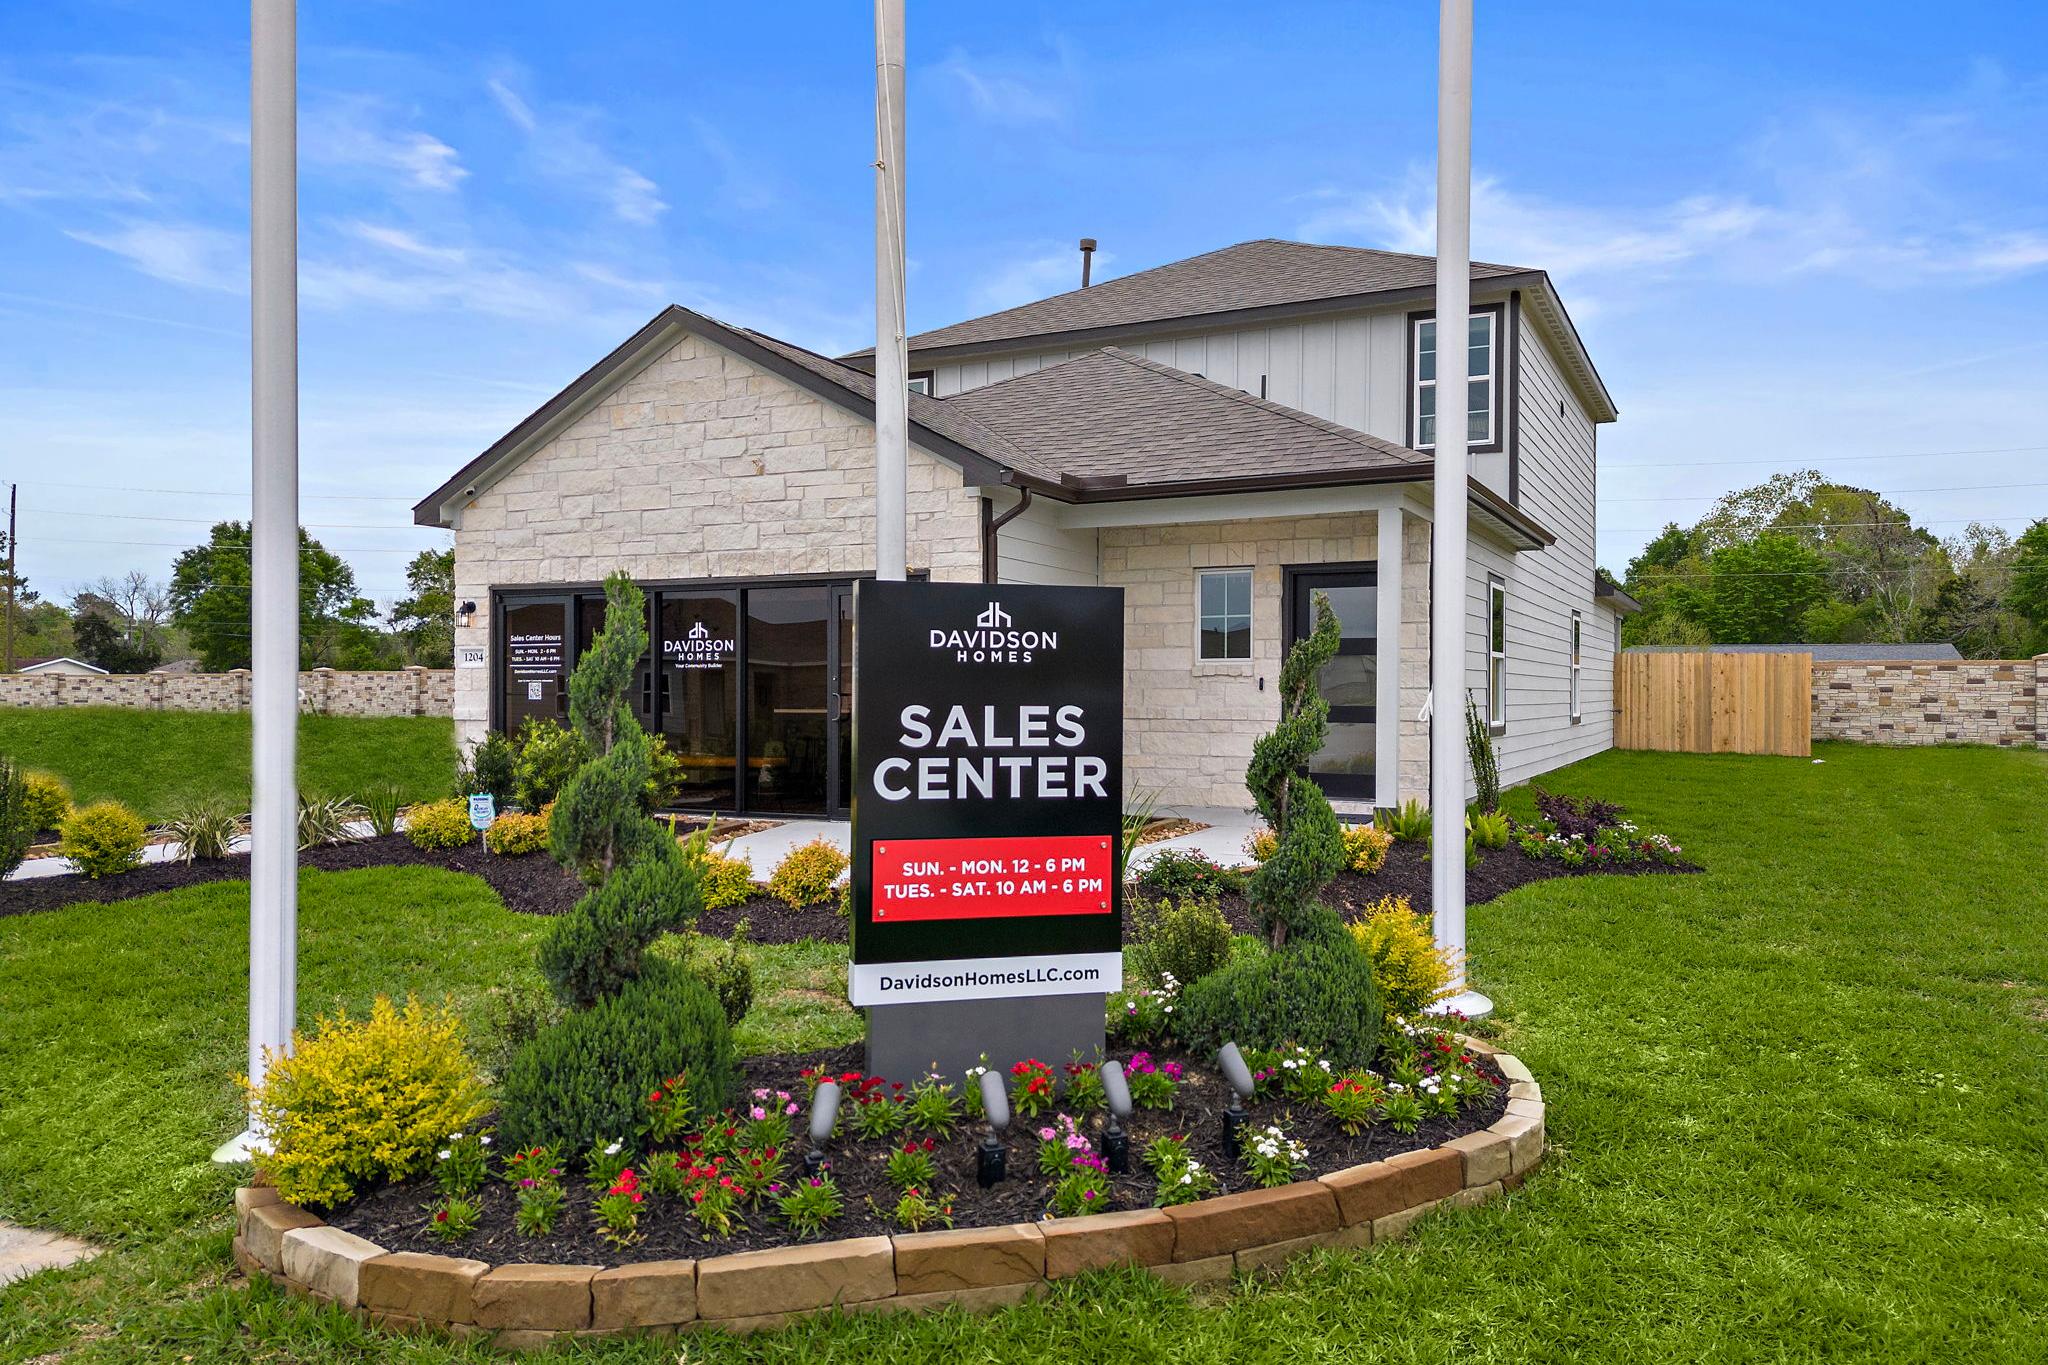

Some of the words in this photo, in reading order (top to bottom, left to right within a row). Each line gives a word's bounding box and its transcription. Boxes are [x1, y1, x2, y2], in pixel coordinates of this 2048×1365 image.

[664, 640, 734, 652] DAVIDSON
[930, 629, 1057, 650] DAVIDSON
[464, 652, 484, 662] 1204
[678, 652, 720, 661] HOMES
[957, 650, 1032, 663] HOMES
[899, 704, 1086, 748] SALES
[873, 756, 1108, 801] CENTER
[902, 861, 944, 877] SUN.
[961, 859, 1007, 875] MON.
[1012, 859, 1029, 873] 12
[1045, 858, 1056, 872] 6
[1061, 857, 1085, 872] PM
[884, 883, 935, 899] TUES.
[951, 881, 991, 897] SAT.
[996, 881, 1015, 895] 10
[1019, 880, 1047, 894] AM
[1062, 879, 1074, 893] 6
[1078, 878, 1102, 892] PM
[880, 967, 1100, 991] DavidsonHomesLLC.com
